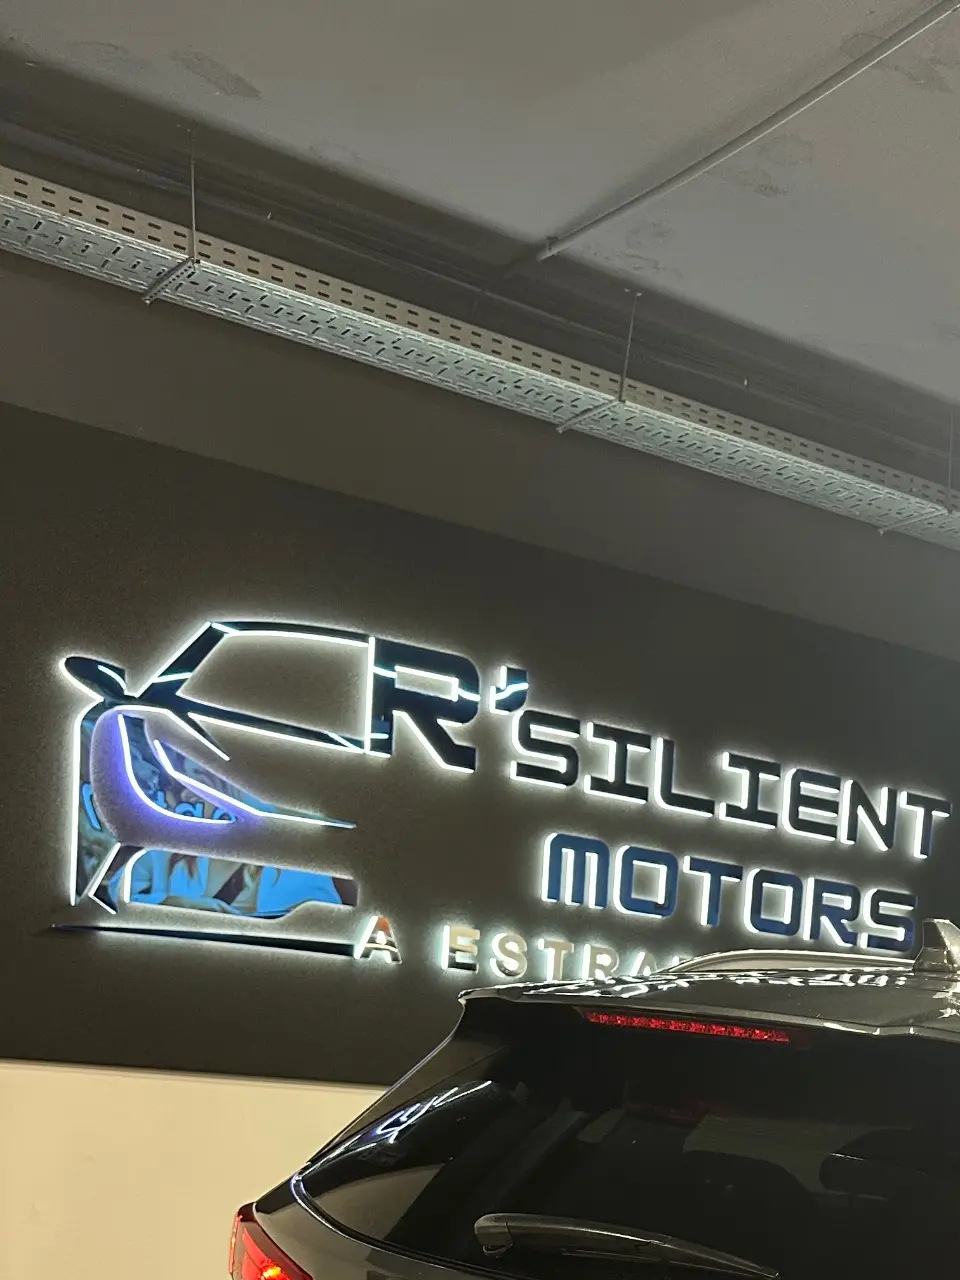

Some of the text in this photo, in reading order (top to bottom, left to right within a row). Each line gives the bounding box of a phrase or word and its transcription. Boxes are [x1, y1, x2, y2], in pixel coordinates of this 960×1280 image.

[541, 832, 918, 953] MOTORS
[353, 914, 691, 981] A ESTRA
